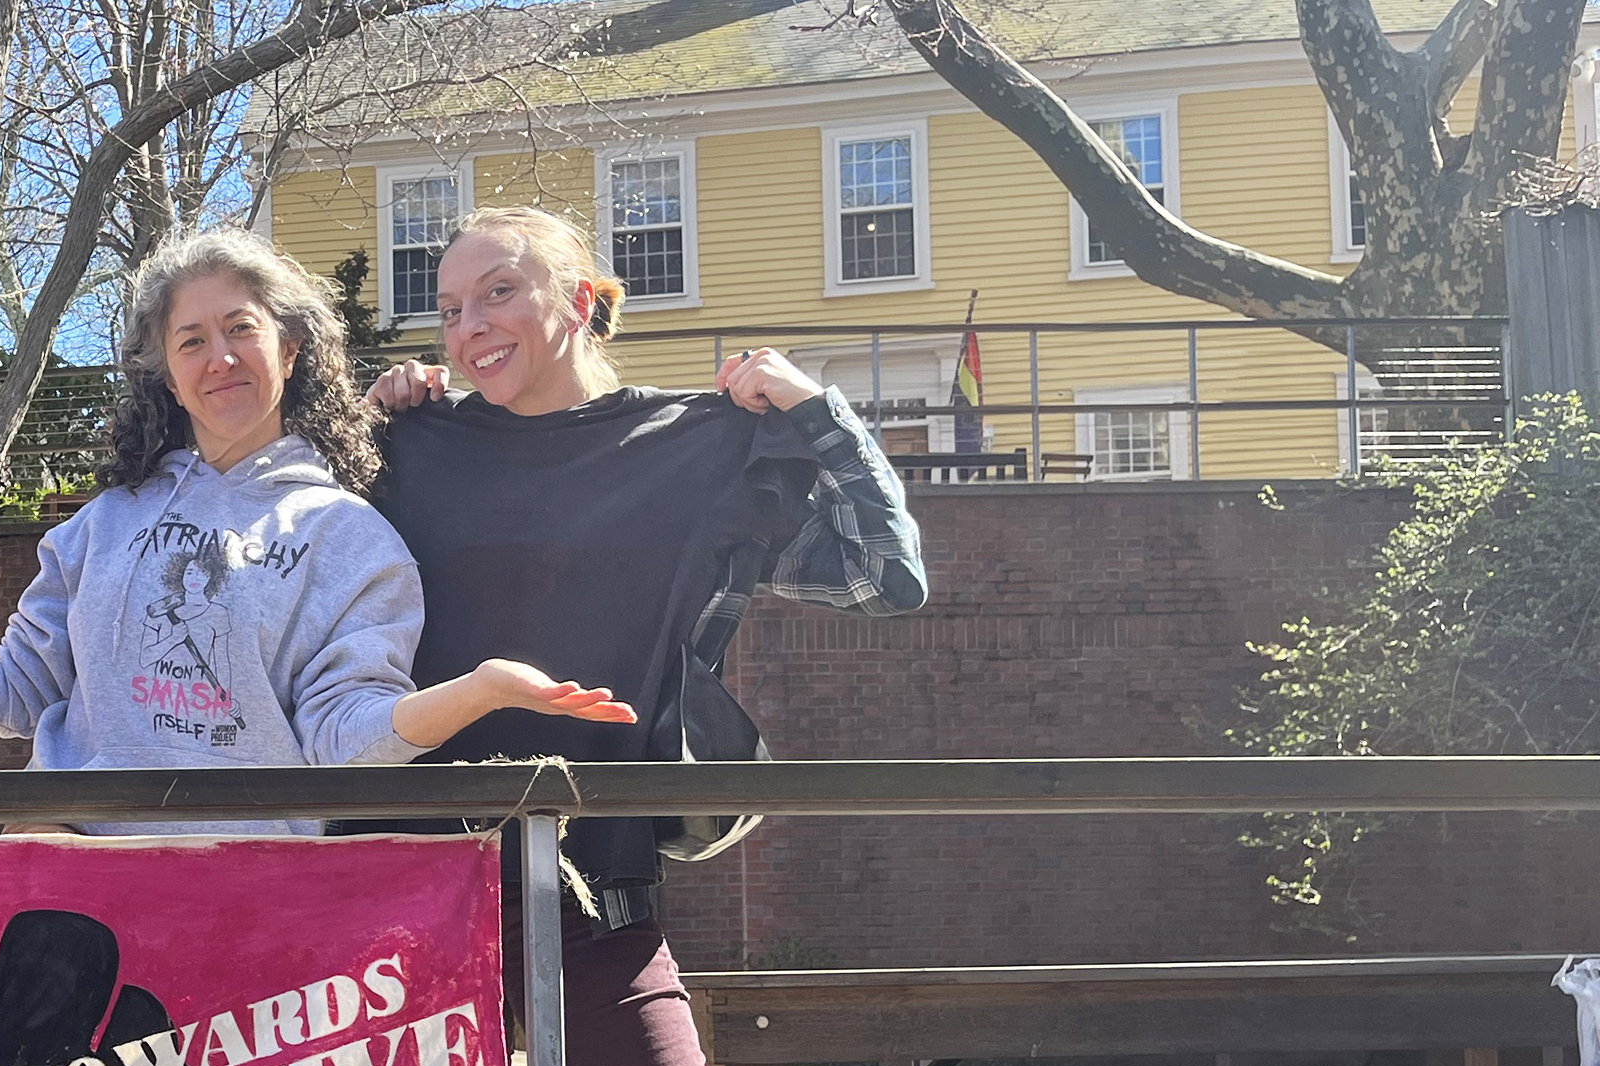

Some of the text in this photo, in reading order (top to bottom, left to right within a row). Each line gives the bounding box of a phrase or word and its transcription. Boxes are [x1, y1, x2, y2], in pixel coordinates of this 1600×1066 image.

[166, 512, 184, 521] THE
[131, 675, 232, 719] SMASH
[153, 713, 205, 740] ITSELF
